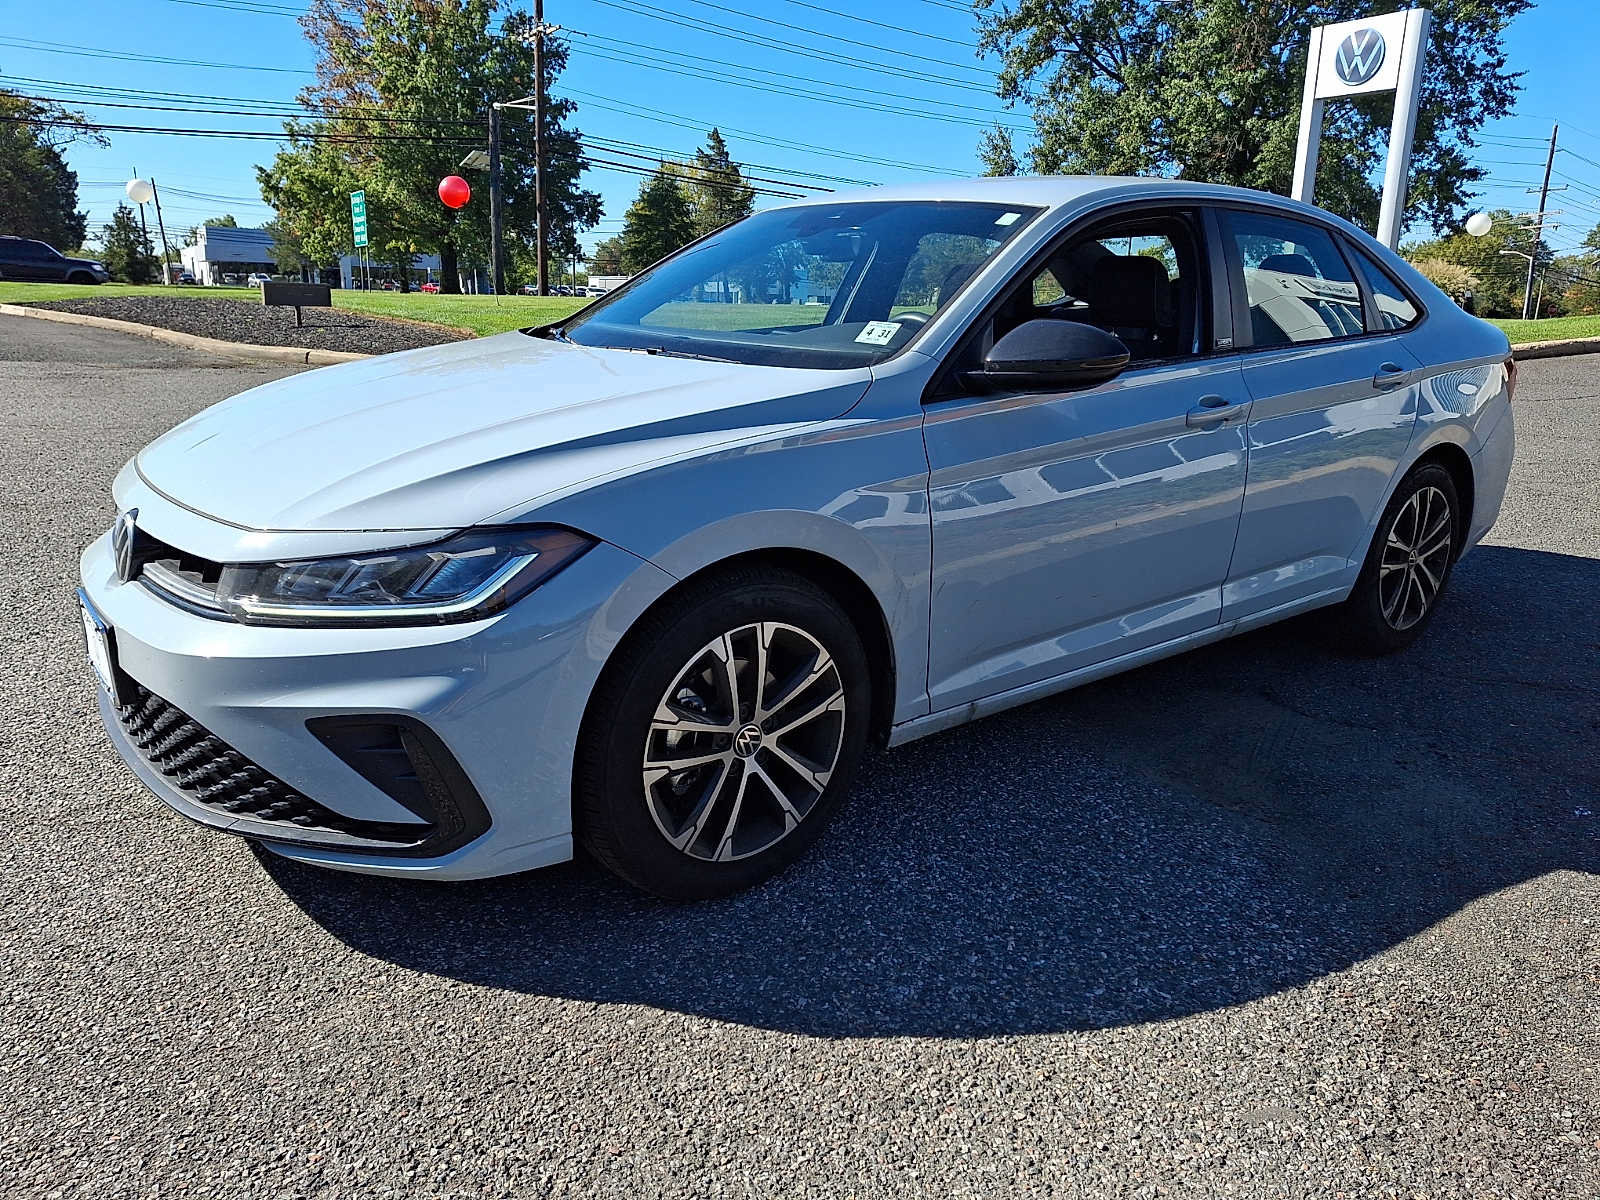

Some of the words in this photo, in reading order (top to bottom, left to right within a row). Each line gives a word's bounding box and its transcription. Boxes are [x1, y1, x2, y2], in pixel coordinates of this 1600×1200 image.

[1337, 28, 1384, 82] VW
[866, 327, 875, 337] 4
[877, 329, 892, 338] 31
